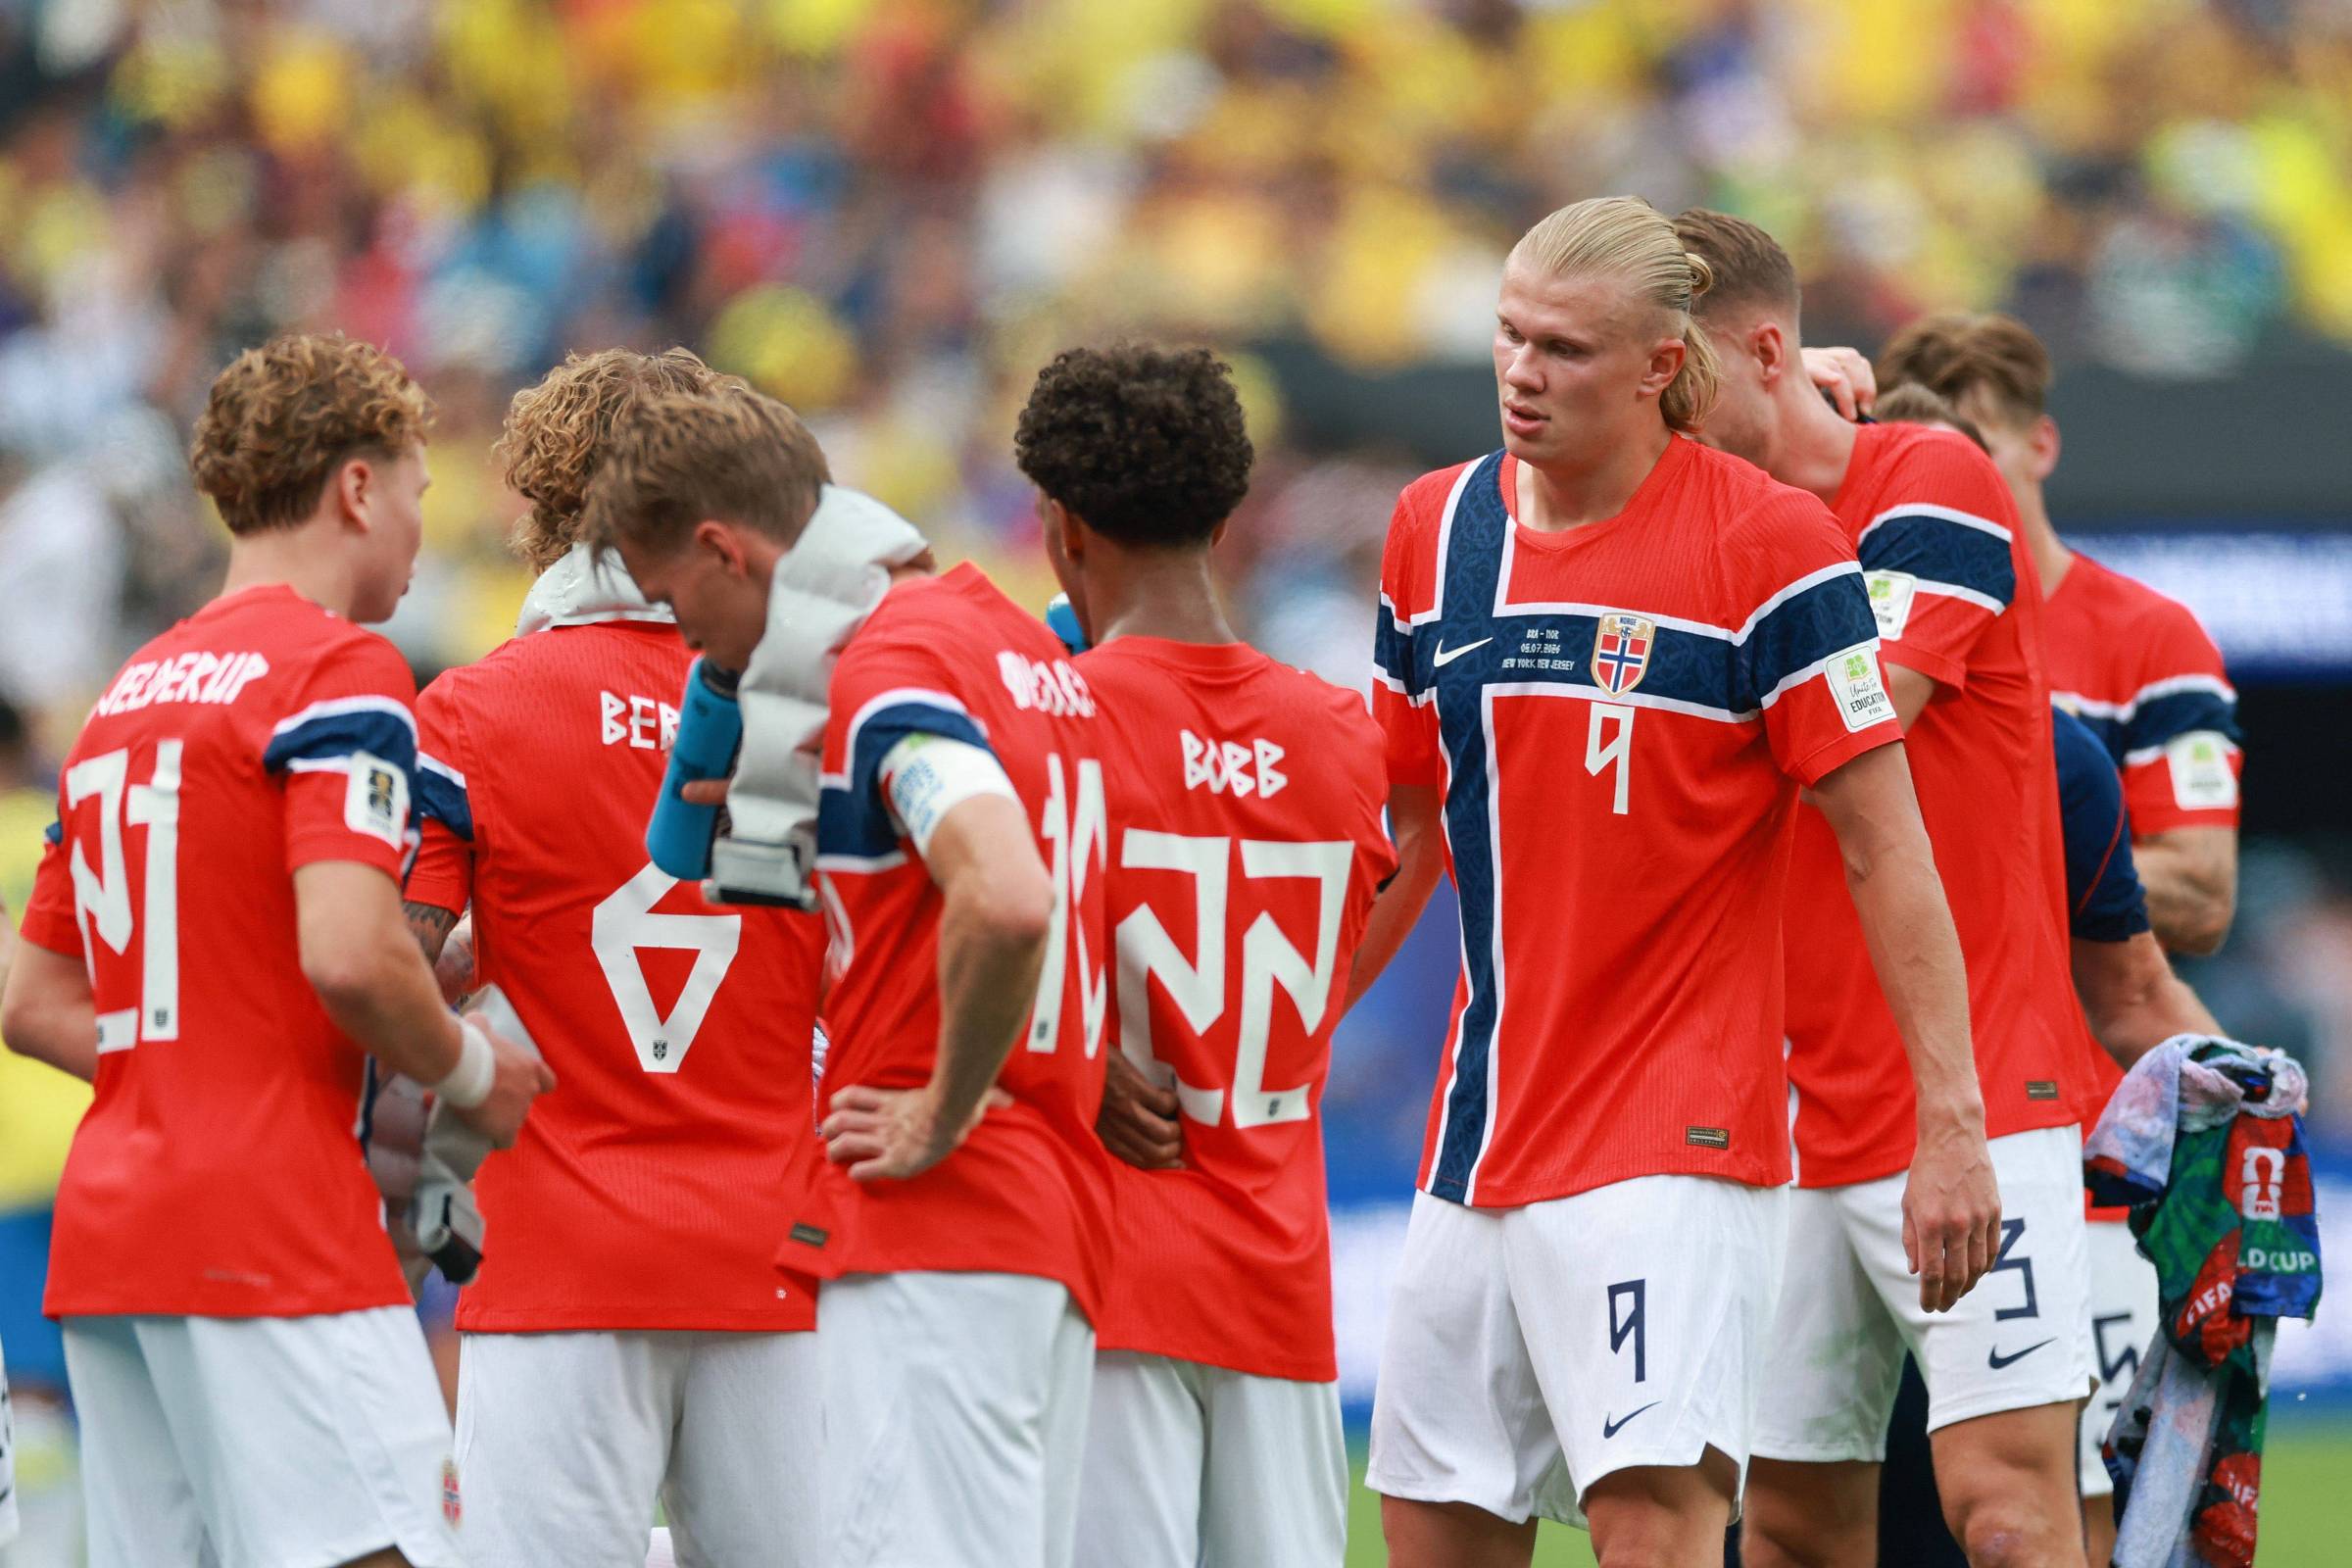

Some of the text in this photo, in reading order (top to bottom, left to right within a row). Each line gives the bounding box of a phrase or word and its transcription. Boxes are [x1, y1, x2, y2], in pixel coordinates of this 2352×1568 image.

[1545, 629, 1559, 640] NOR
[1620, 616, 1637, 626] NORGE
[1501, 659, 1516, 668] NEW
[1537, 659, 1550, 669] NEW
[1550, 660, 1575, 670] JERSEY
[1849, 691, 1886, 713] EDUCATION
[1868, 707, 1883, 715] FIFA
[1180, 729, 1288, 798] BOBB
[1584, 701, 1636, 815] 9
[66, 738, 184, 1054] 21
[591, 860, 742, 1074] 6
[1114, 827, 1355, 1130] 22
[1990, 1217, 2039, 1322] 3
[2269, 1250, 2317, 1274] CUP
[1607, 1278, 1646, 1384] 9
